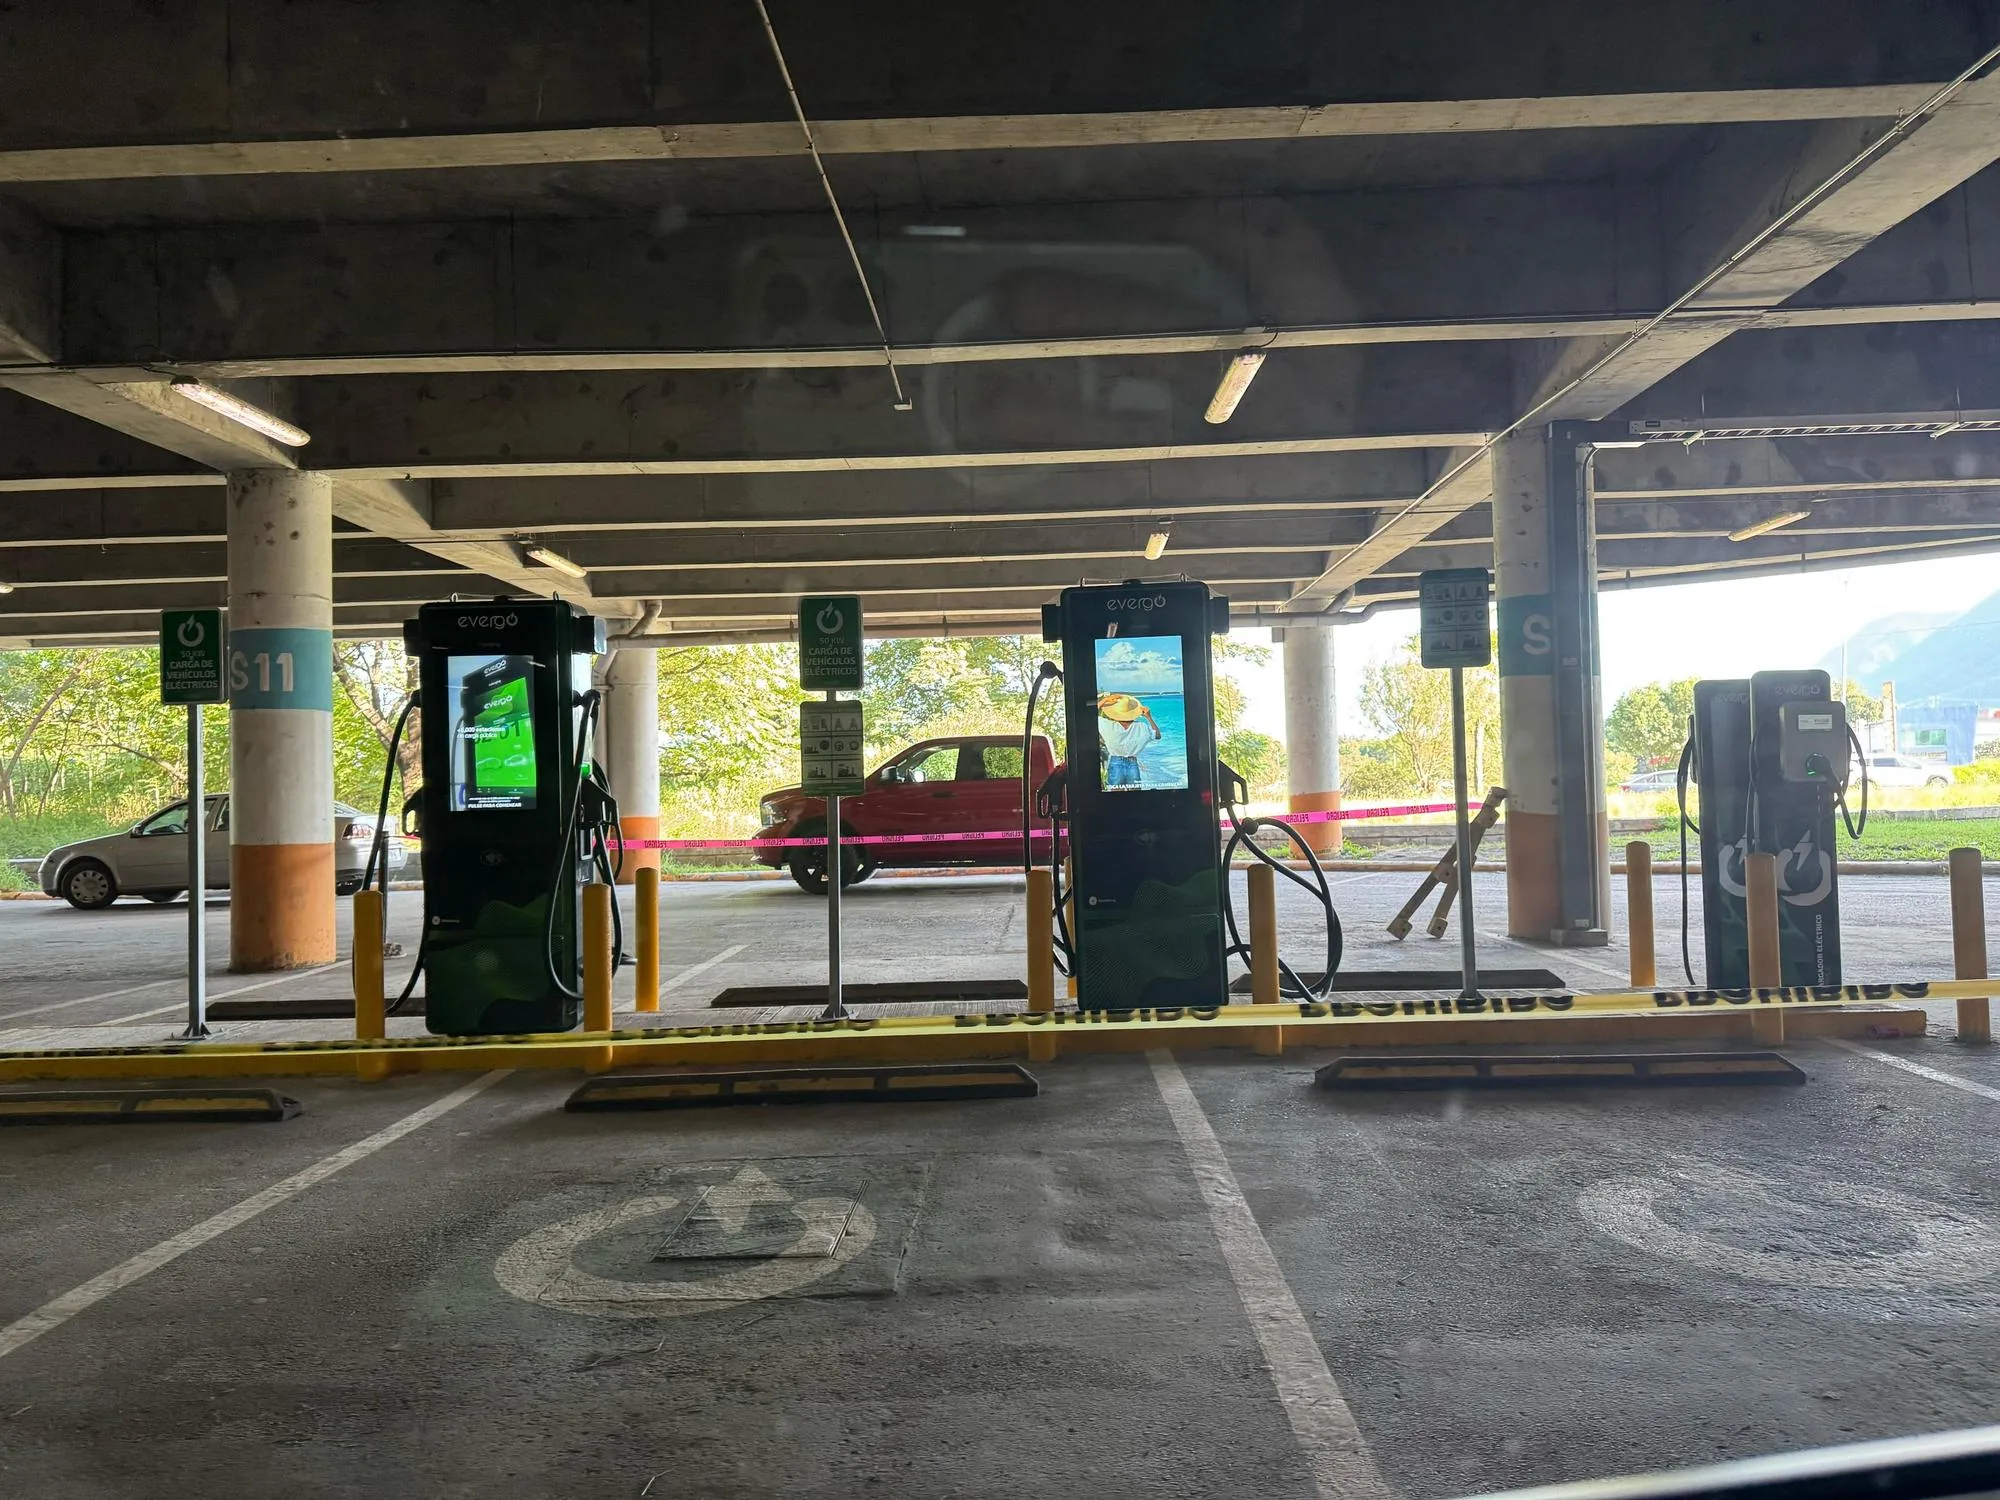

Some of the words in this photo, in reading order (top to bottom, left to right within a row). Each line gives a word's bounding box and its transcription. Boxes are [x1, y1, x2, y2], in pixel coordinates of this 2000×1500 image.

[808, 647, 839, 656] CARGA
[841, 647, 853, 655] DE
[169, 660, 200, 669] CARGA
[201, 659, 214, 668] DE
[806, 656, 856, 665] VEHÍCULOS
[166, 670, 217, 680] VEHÍCULOS
[230, 650, 294, 692] S11
[804, 667, 858, 677] ELÉCTRICOS
[165, 680, 219, 690] ELÉCTRICOS
